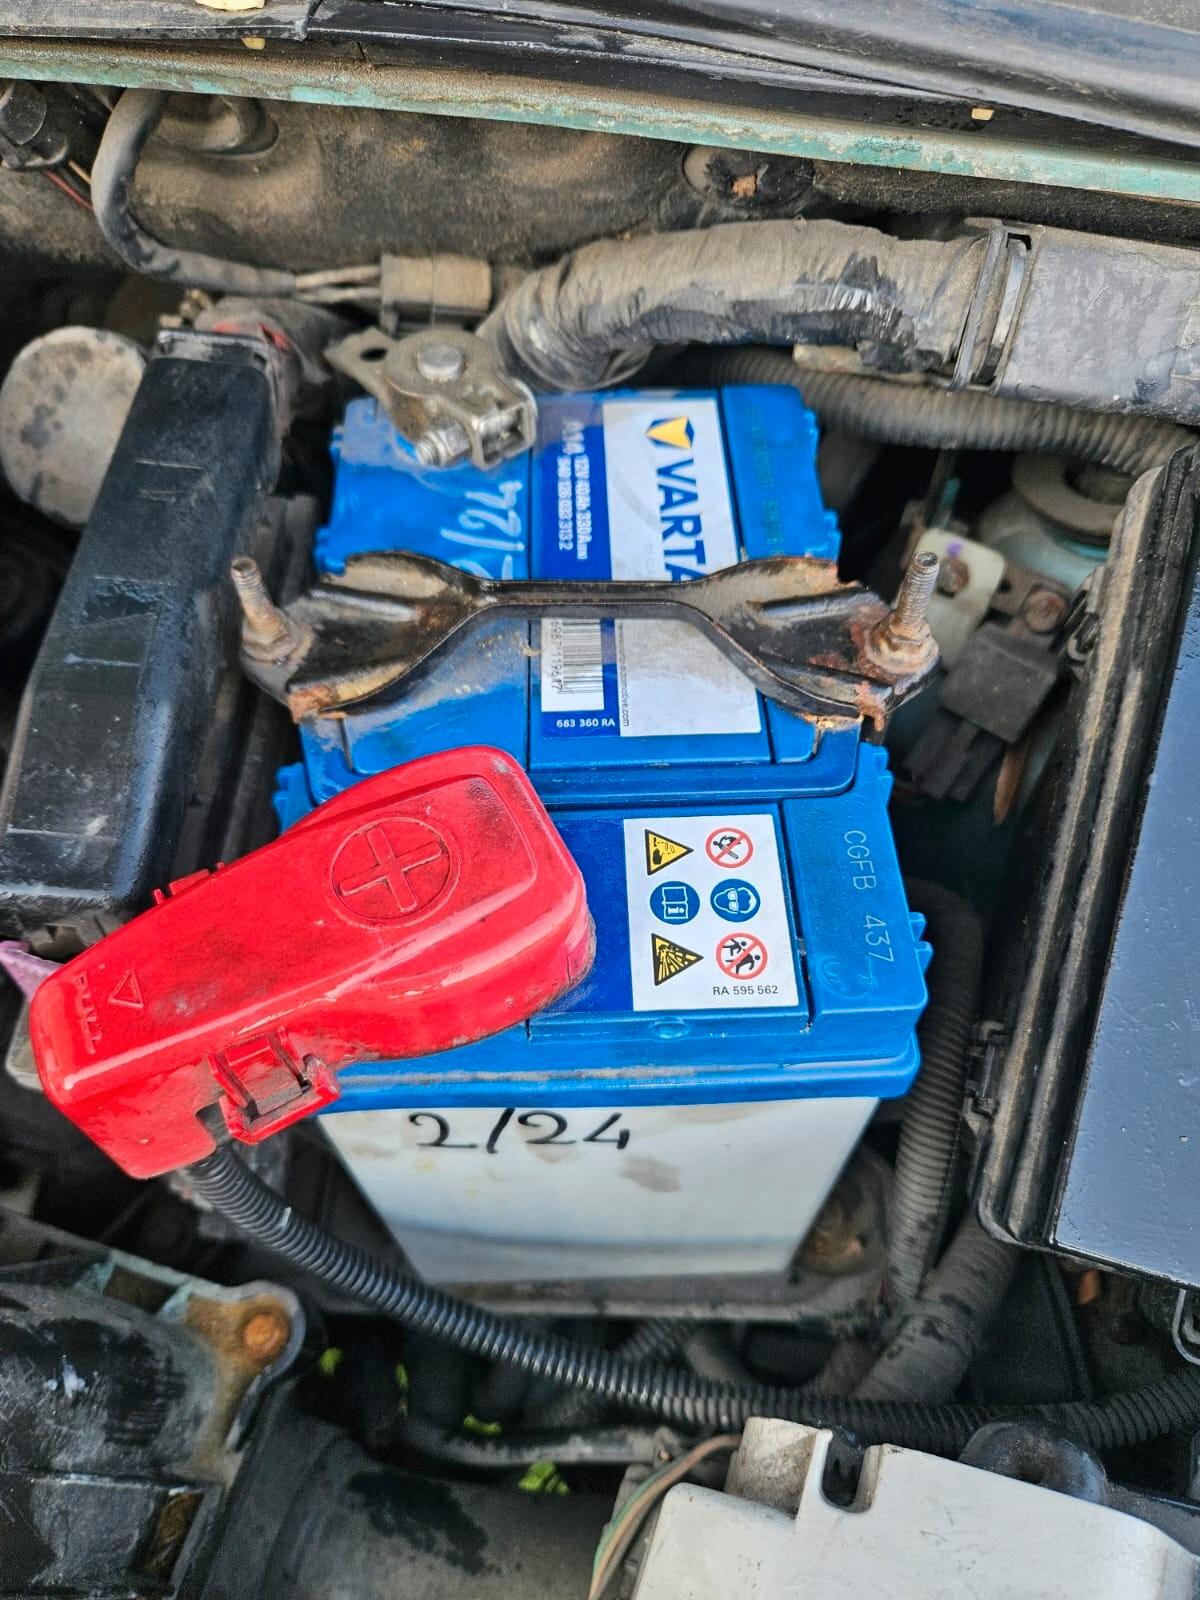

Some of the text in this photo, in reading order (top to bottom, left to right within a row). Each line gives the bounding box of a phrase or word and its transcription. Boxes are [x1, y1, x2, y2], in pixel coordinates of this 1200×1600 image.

[574, 454, 590, 478] 12V
[557, 454, 573, 550] 540 126 033 313 2
[575, 479, 591, 510] 40Ah
[556, 718, 616, 728] 683 360 RA
[843, 830, 895, 963] CGFB 437
[712, 984, 778, 995] RA 595 562
[408, 1107, 631, 1154] 2/24
